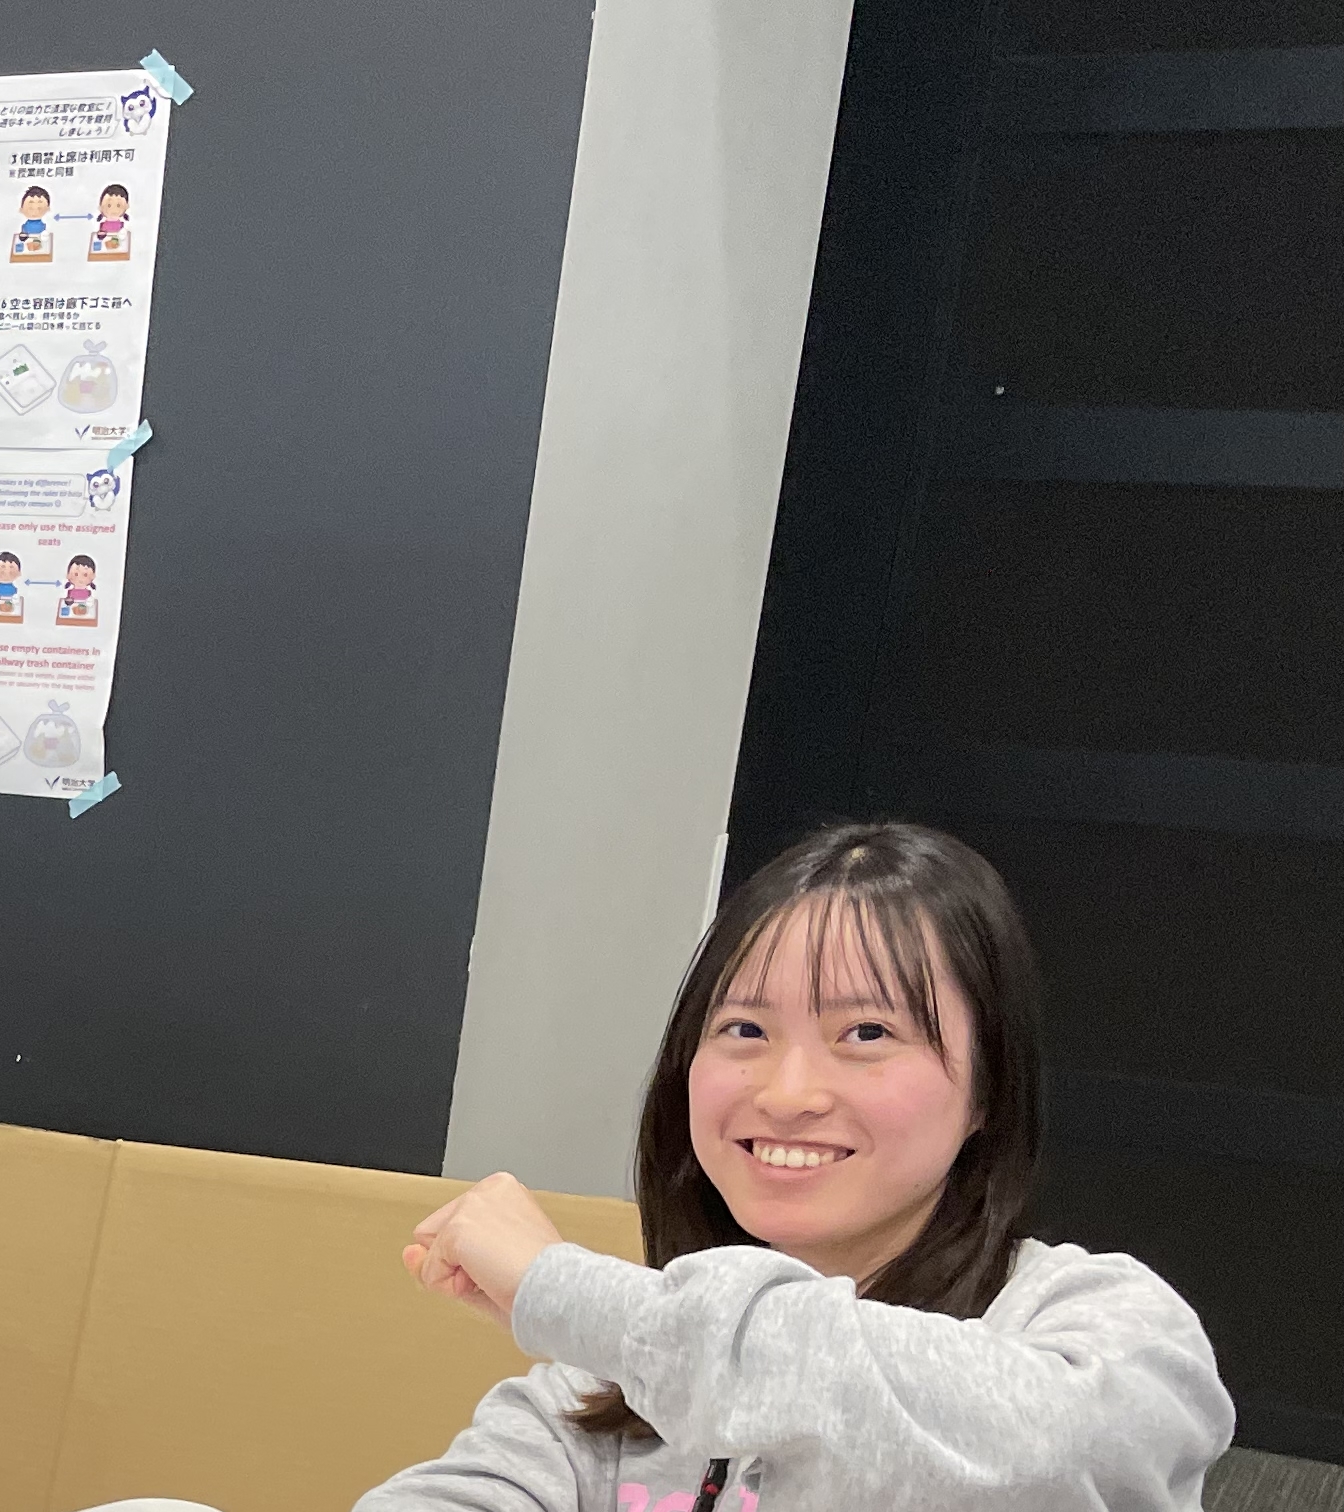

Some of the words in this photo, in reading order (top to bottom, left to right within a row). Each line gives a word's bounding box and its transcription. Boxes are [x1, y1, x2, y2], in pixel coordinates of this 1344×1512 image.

[18, 522, 38, 533] only
[40, 523, 55, 532] use
[59, 523, 73, 532] the
[75, 524, 116, 534] assigned
[38, 538, 61, 546] seats
[11, 644, 39, 654] empty
[42, 645, 89, 656] containers
[92, 647, 100, 656] in
[26, 659, 49, 668] trash
[51, 660, 95, 670] container
